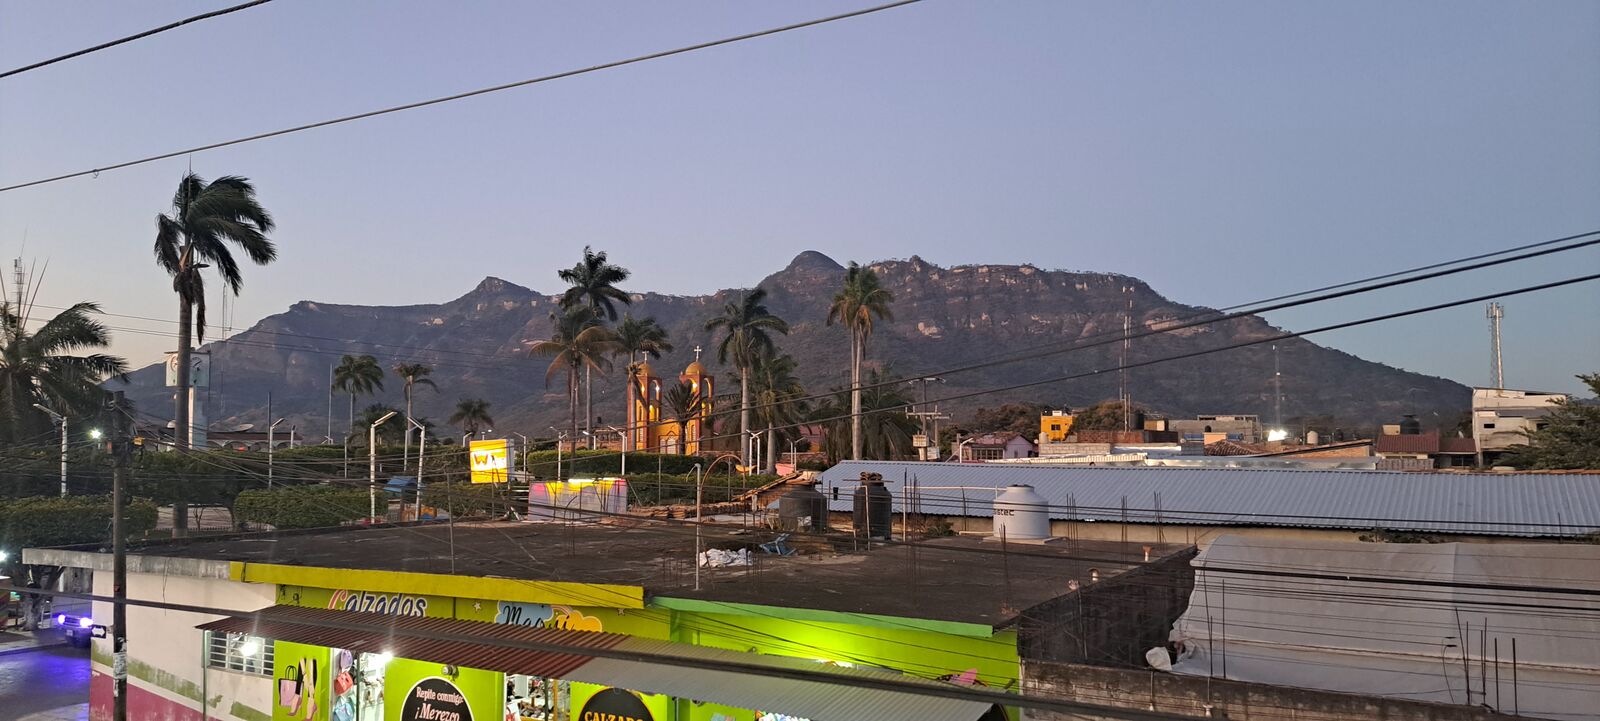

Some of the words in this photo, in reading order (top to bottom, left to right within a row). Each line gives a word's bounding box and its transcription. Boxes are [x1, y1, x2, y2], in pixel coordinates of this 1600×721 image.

[328, 589, 428, 618] Calzados
[416, 686, 436, 701] Repite
[585, 711, 644, 721] CALZA
